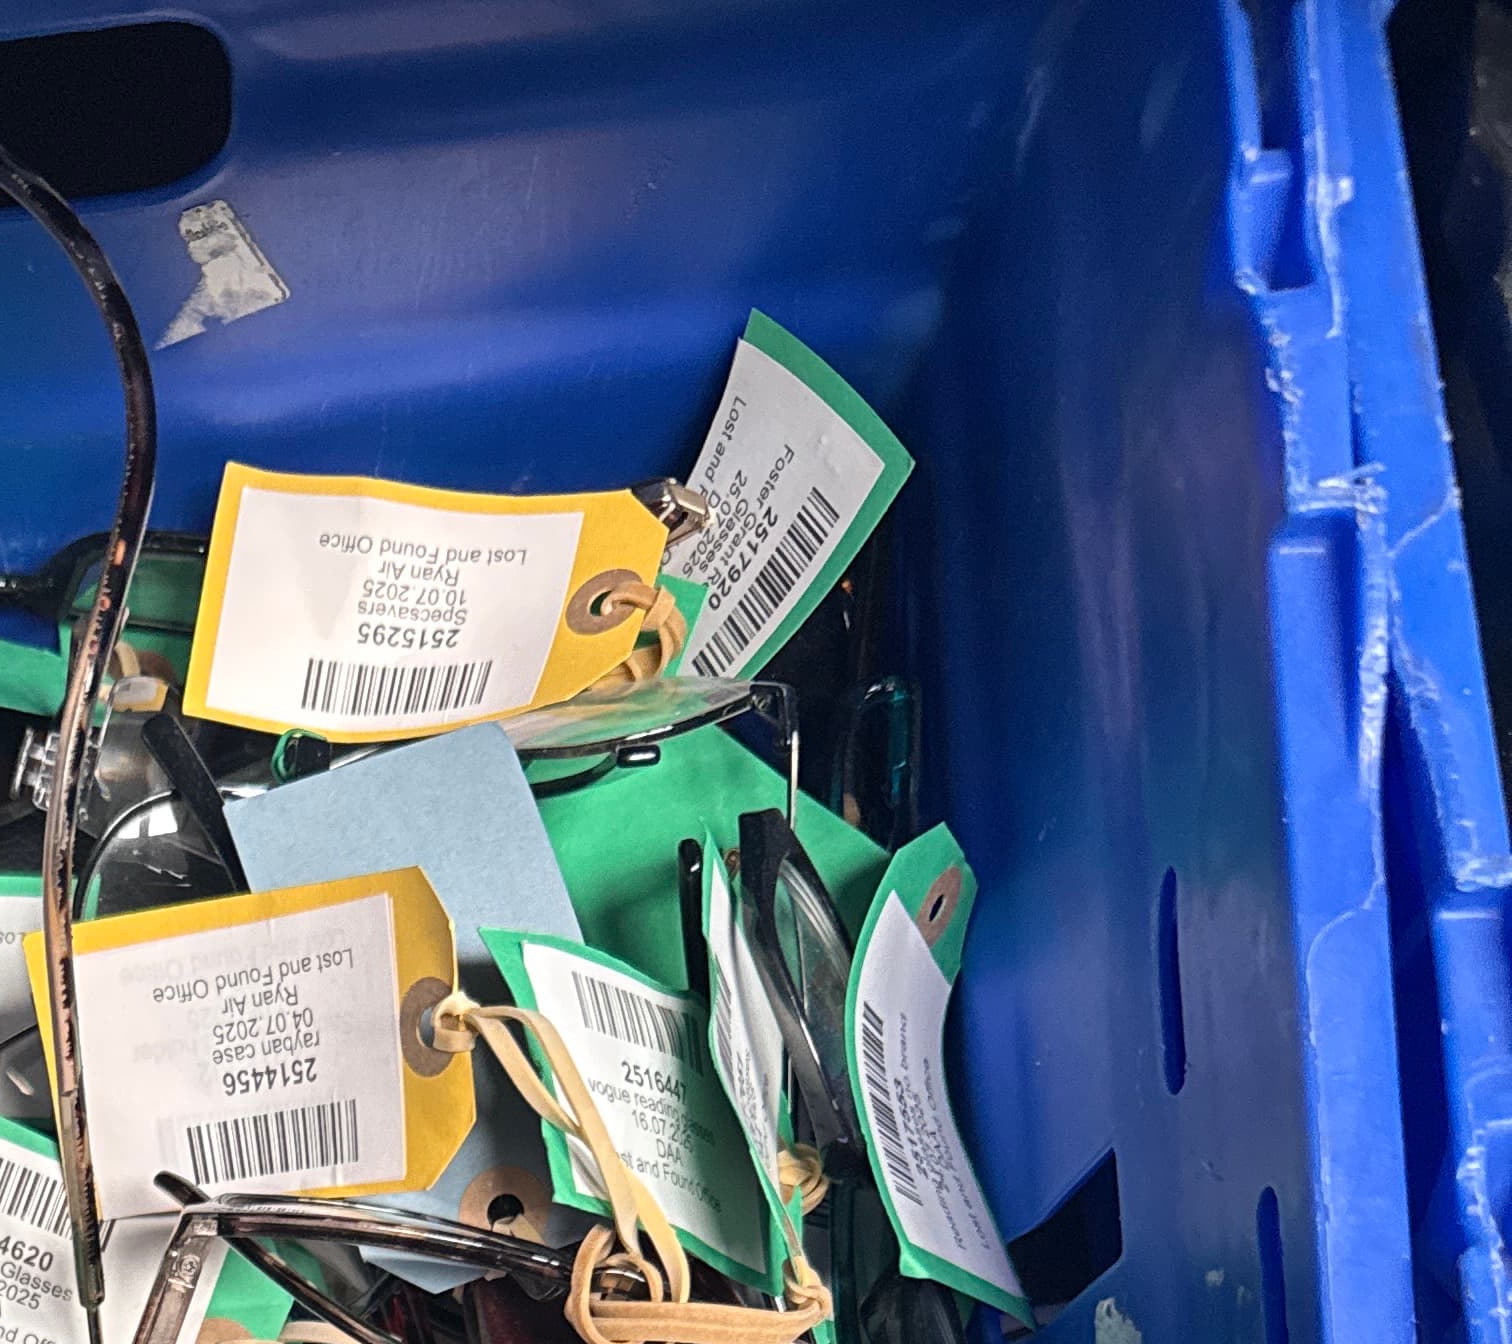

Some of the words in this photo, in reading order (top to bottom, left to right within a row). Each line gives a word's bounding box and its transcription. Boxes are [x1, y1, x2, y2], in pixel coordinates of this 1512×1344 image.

[721, 395, 746, 440] Lost
[704, 441, 725, 483] and
[756, 445, 794, 508] Foster
[319, 533, 372, 553] Office
[698, 498, 748, 573] Glasses
[719, 511, 757, 566] Grant
[379, 538, 437, 564] Found
[445, 548, 480, 564] and
[486, 548, 525, 565] Lost
[707, 508, 778, 610] 2517920
[377, 560, 404, 578] Air
[410, 564, 458, 586] Ryan
[362, 579, 464, 605] 10.07.2025
[357, 600, 466, 625] Specsavers
[357, 623, 459, 648] 2515295
[278, 956, 311, 980] and
[315, 947, 353, 973] Lost
[152, 979, 208, 1003] Office
[215, 965, 273, 994] Found
[221, 994, 246, 1016] Air
[251, 983, 298, 1007] Ryan
[212, 1007, 313, 1045] 04.07.2025
[211, 1043, 255, 1064] case
[261, 1029, 319, 1056] rayban
[222, 1056, 317, 1096] 2514456
[622, 1060, 687, 1106] 2516447
[587, 1077, 631, 1104] vogue
[655, 1138, 684, 1167] DAA
[636, 1157, 660, 1179] and
[0, 1260, 72, 1301] Glasses
